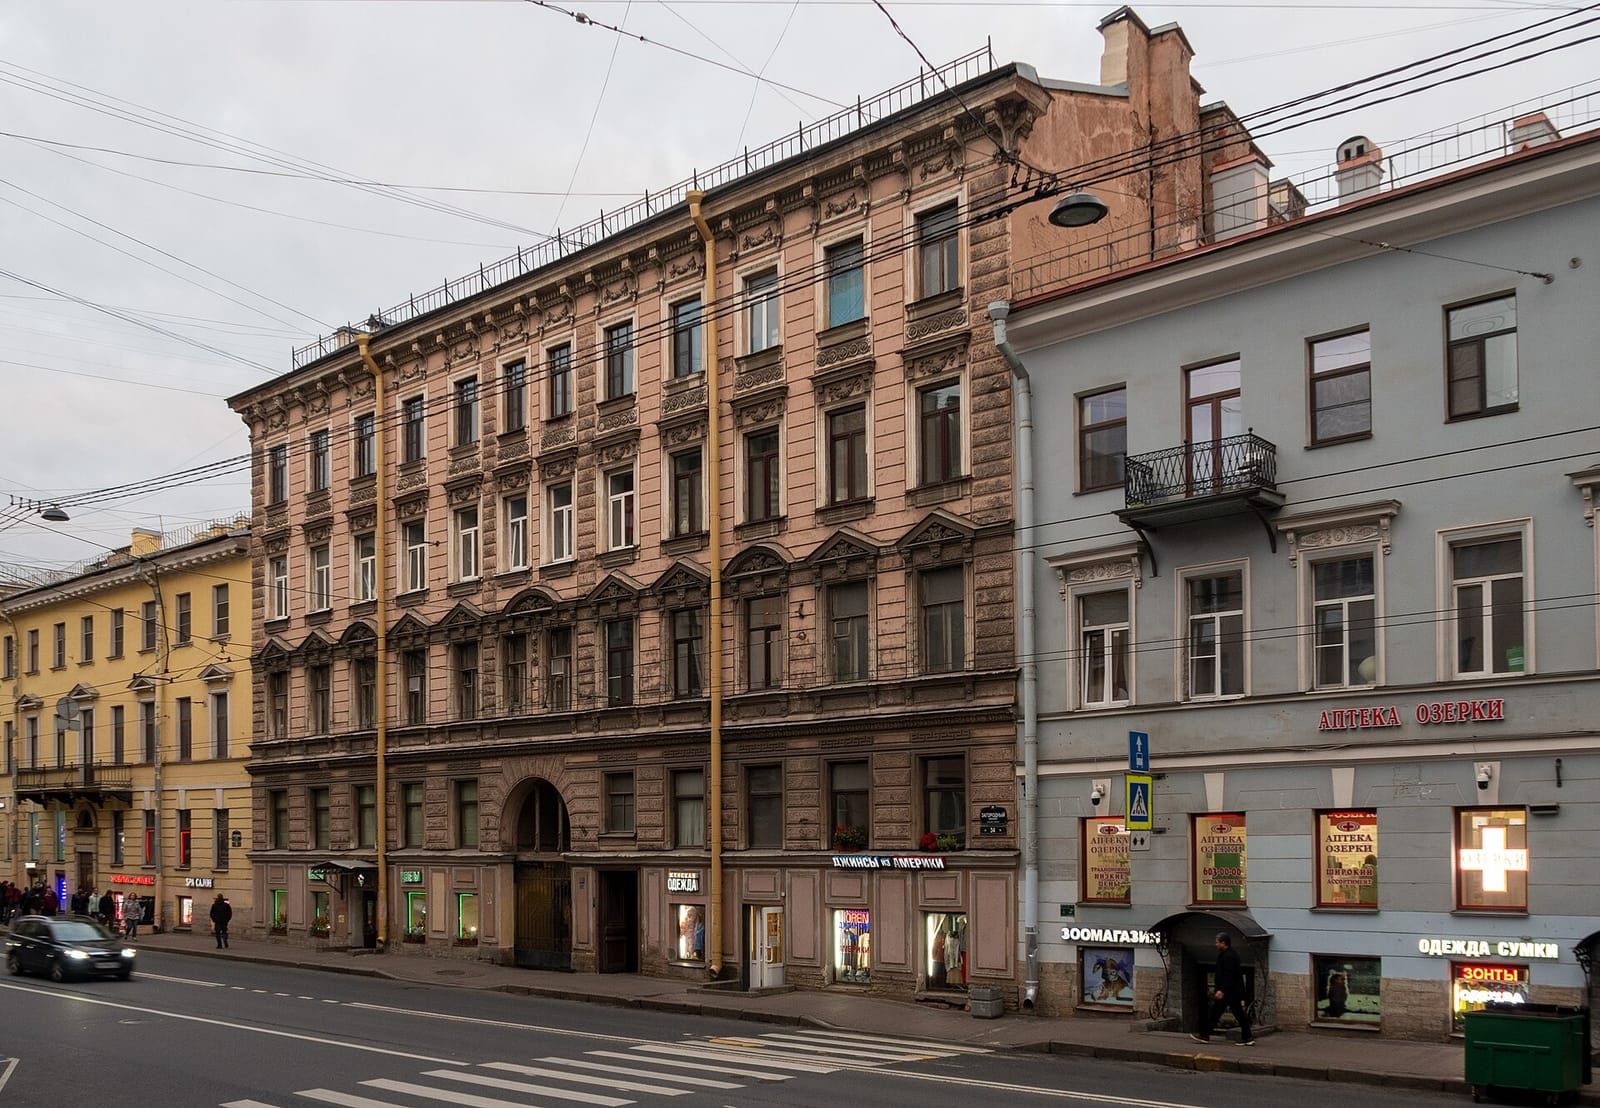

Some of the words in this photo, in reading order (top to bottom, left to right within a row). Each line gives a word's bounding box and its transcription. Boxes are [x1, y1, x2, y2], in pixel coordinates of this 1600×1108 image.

[1318, 706, 1401, 731] АПТЕКА
[1415, 698, 1505, 725] ОЗЕРКИ
[1090, 837, 1129, 845] АПТЕКА
[1200, 835, 1243, 844] АПТЕКА
[1325, 834, 1373, 843] АПТЕКА
[1090, 846, 1129, 854] ОЗЕРКИ
[1200, 845, 1243, 853] ОЗЕРКИ
[1325, 844, 1373, 853] ОЗЕРКИ
[832, 857, 880, 868] ДЖИНСЫ
[893, 857, 945, 869] АМЕРИКИ
[1326, 867, 1373, 876] ШИРОКИЙ
[667, 878, 698, 892] ОДЕЖДА
[1419, 939, 1490, 957] ОДЕЖДА
[1497, 941, 1559, 959] СУМКИ
[1463, 967, 1518, 981] ЗОНТЫ
